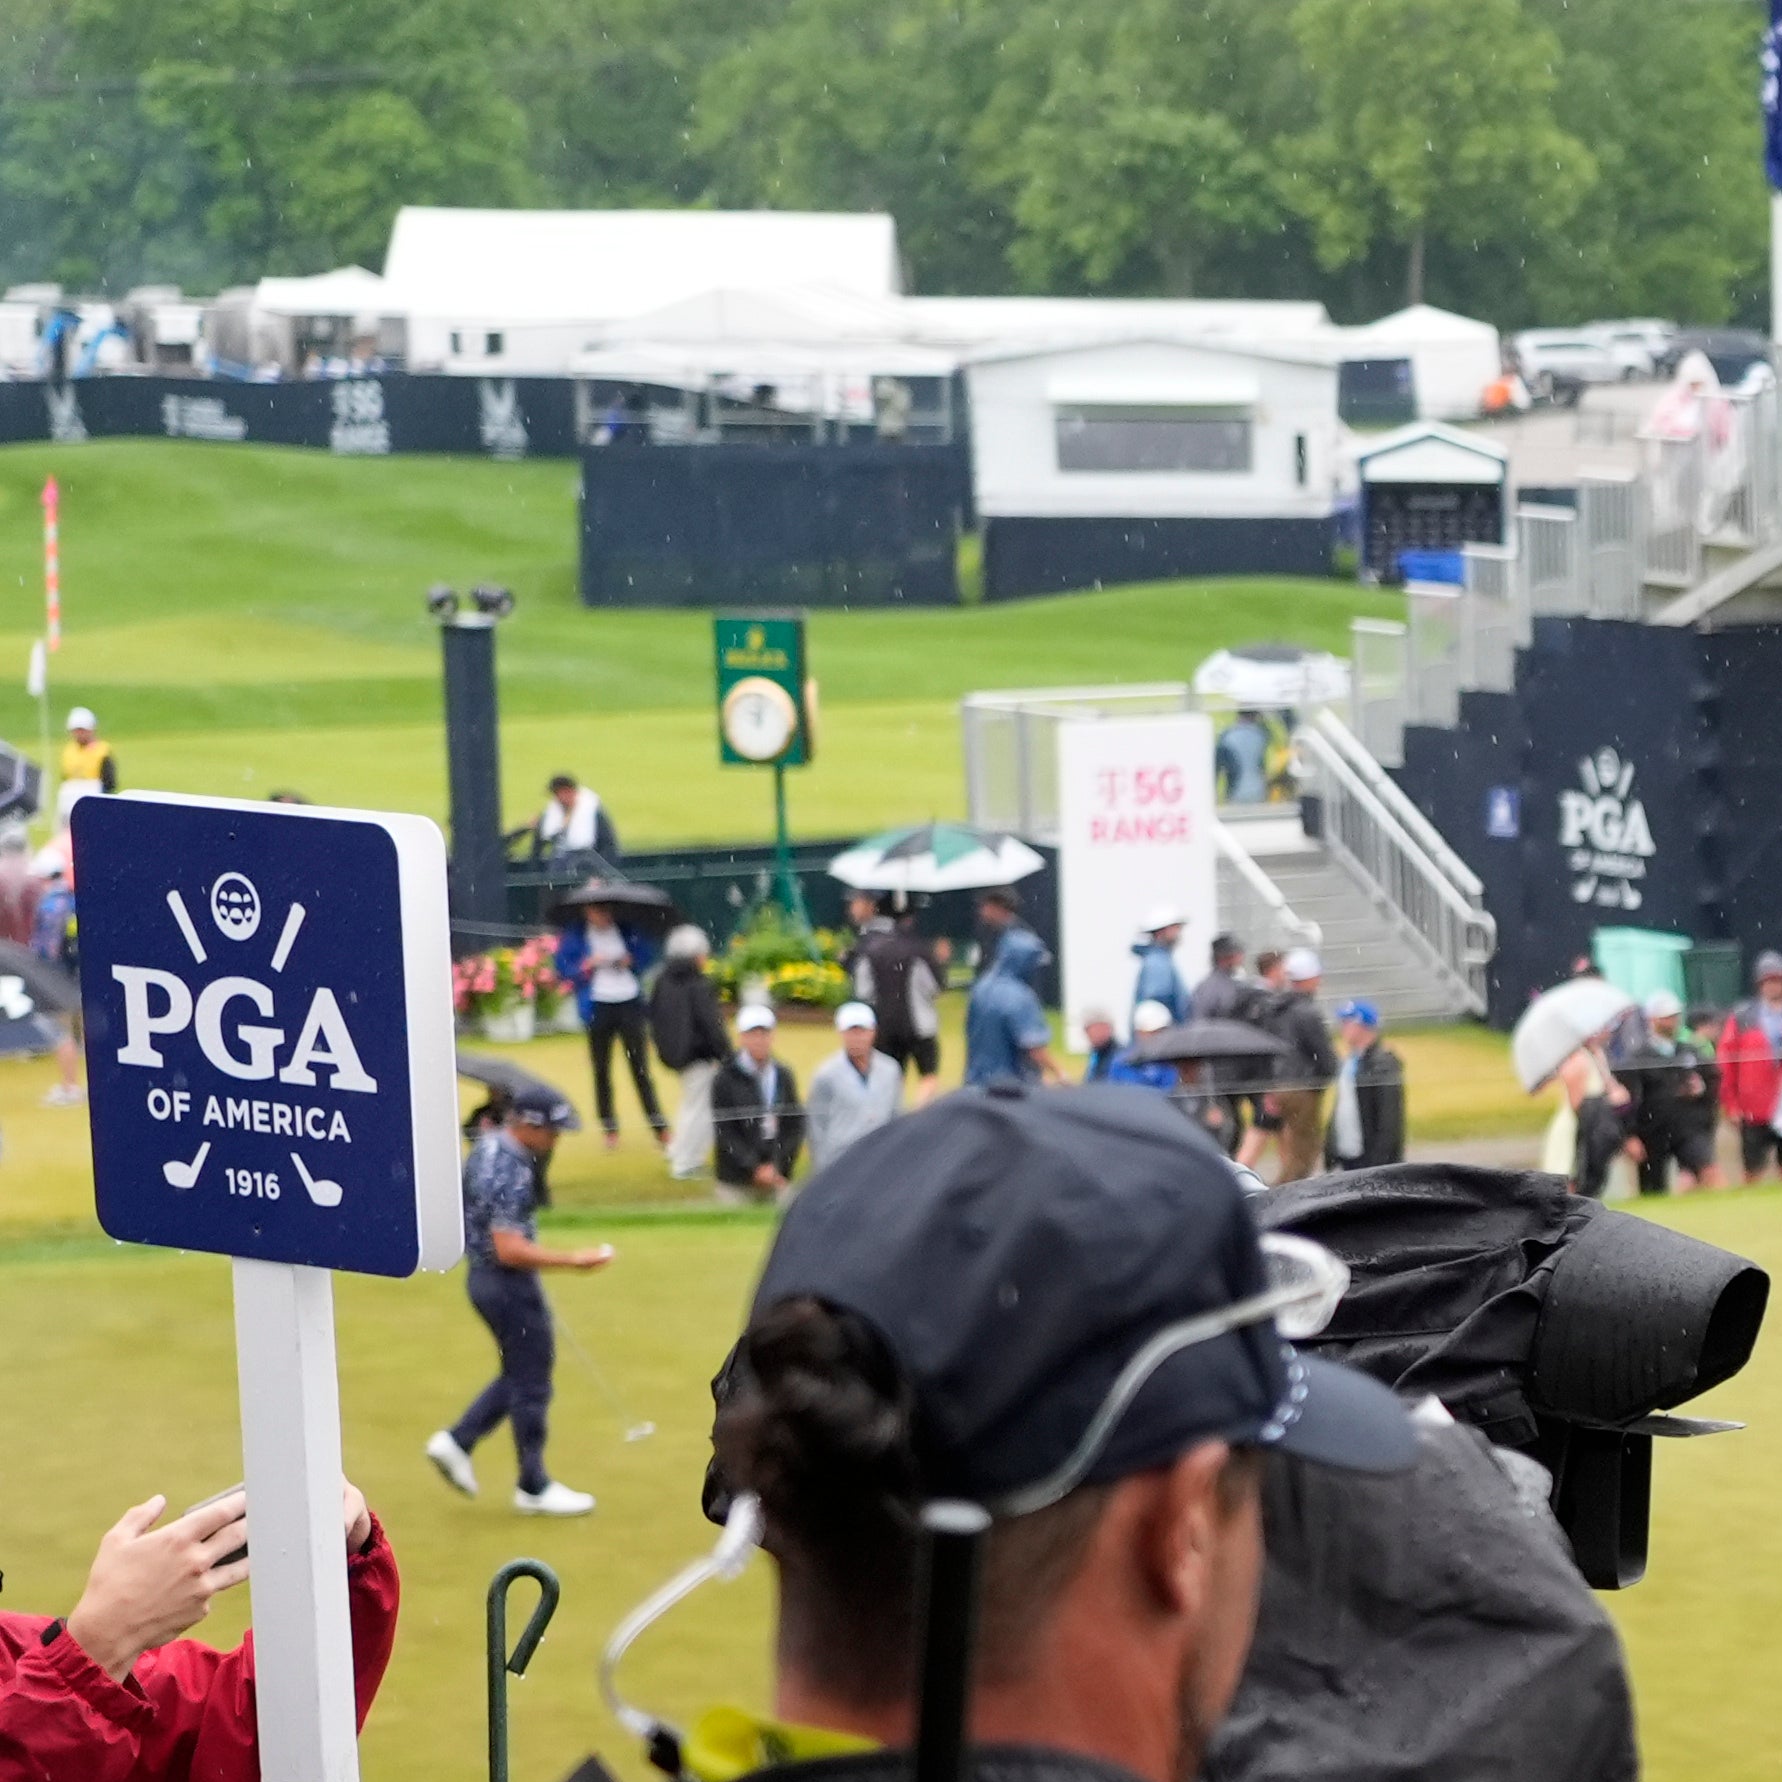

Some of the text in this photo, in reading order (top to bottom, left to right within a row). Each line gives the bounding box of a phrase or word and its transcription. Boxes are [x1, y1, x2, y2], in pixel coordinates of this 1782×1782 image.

[1134, 765, 1184, 806] 5G
[1090, 814, 1191, 845] RANGE
[1558, 791, 1657, 857] PGA
[111, 963, 378, 1094] PGA
[147, 1087, 352, 1144] OF AMERICA
[225, 1168, 281, 1201] 1916
